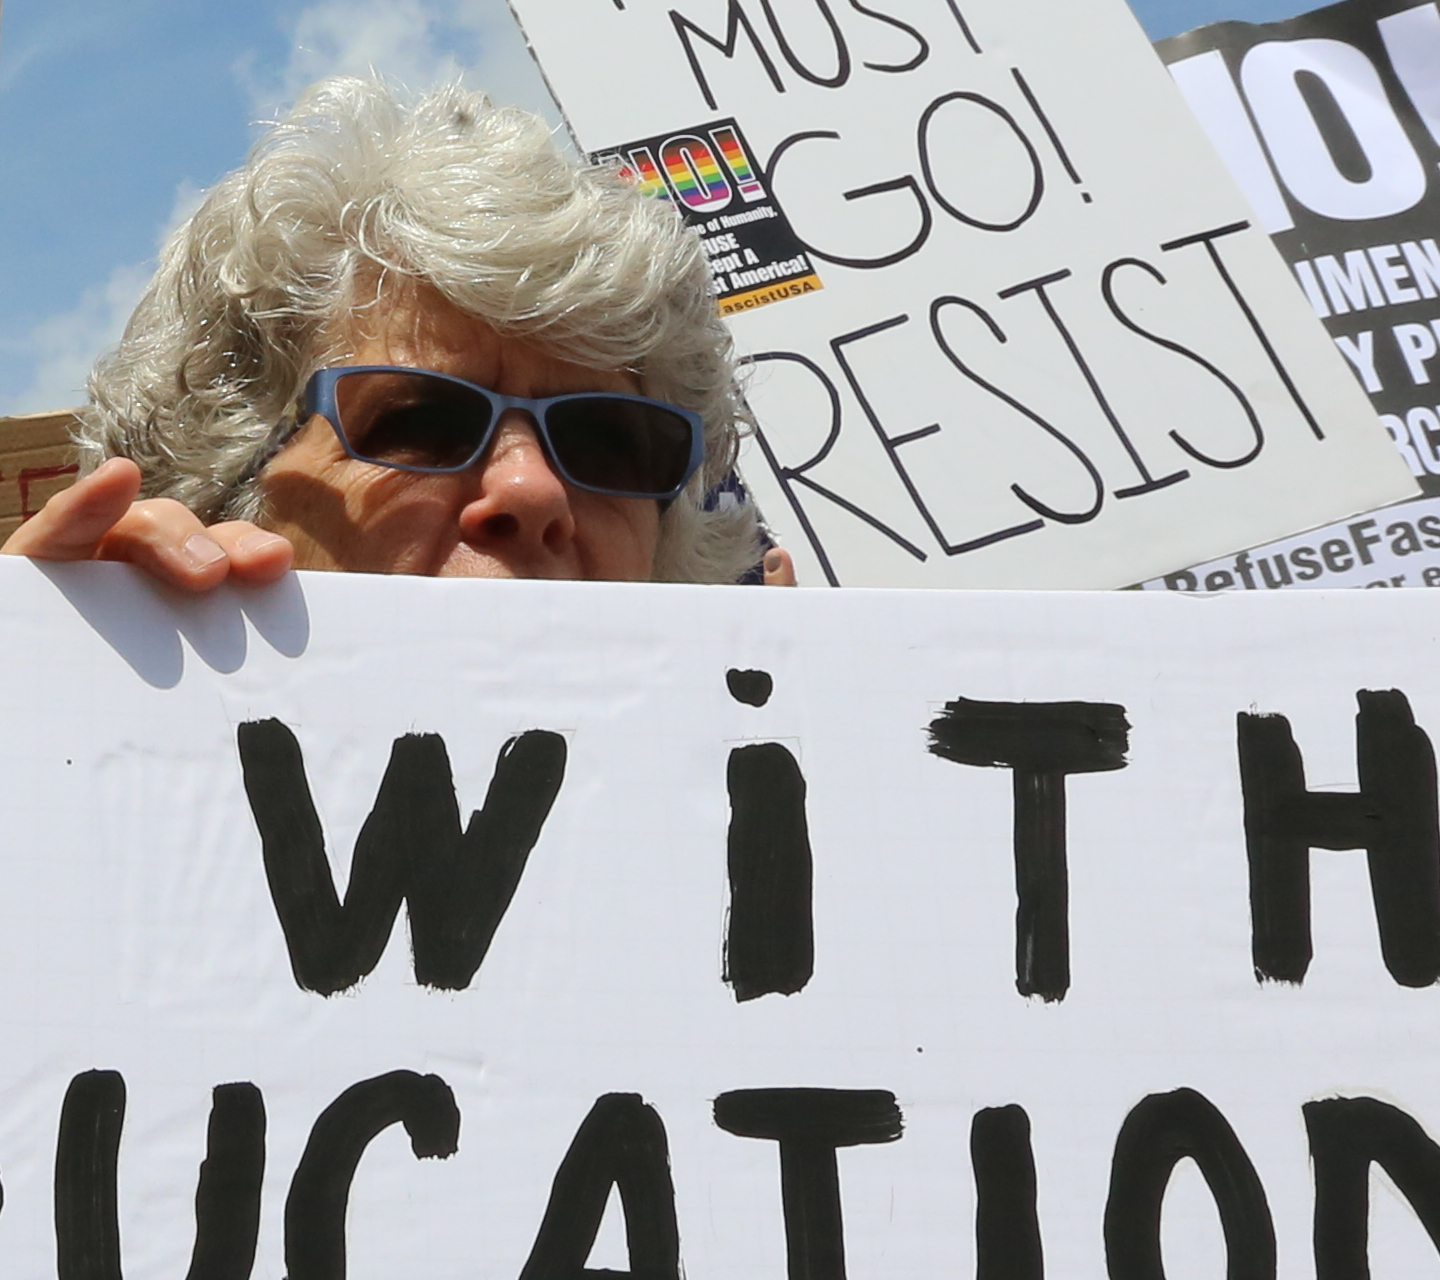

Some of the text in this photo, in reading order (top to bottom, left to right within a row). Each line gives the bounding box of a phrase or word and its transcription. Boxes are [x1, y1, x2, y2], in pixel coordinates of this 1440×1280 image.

[765, 67, 1093, 271] GO!
[707, 216, 721, 232] of
[729, 254, 810, 290] America!
[743, 247, 760, 265] A
[732, 221, 1326, 588] RESIST
